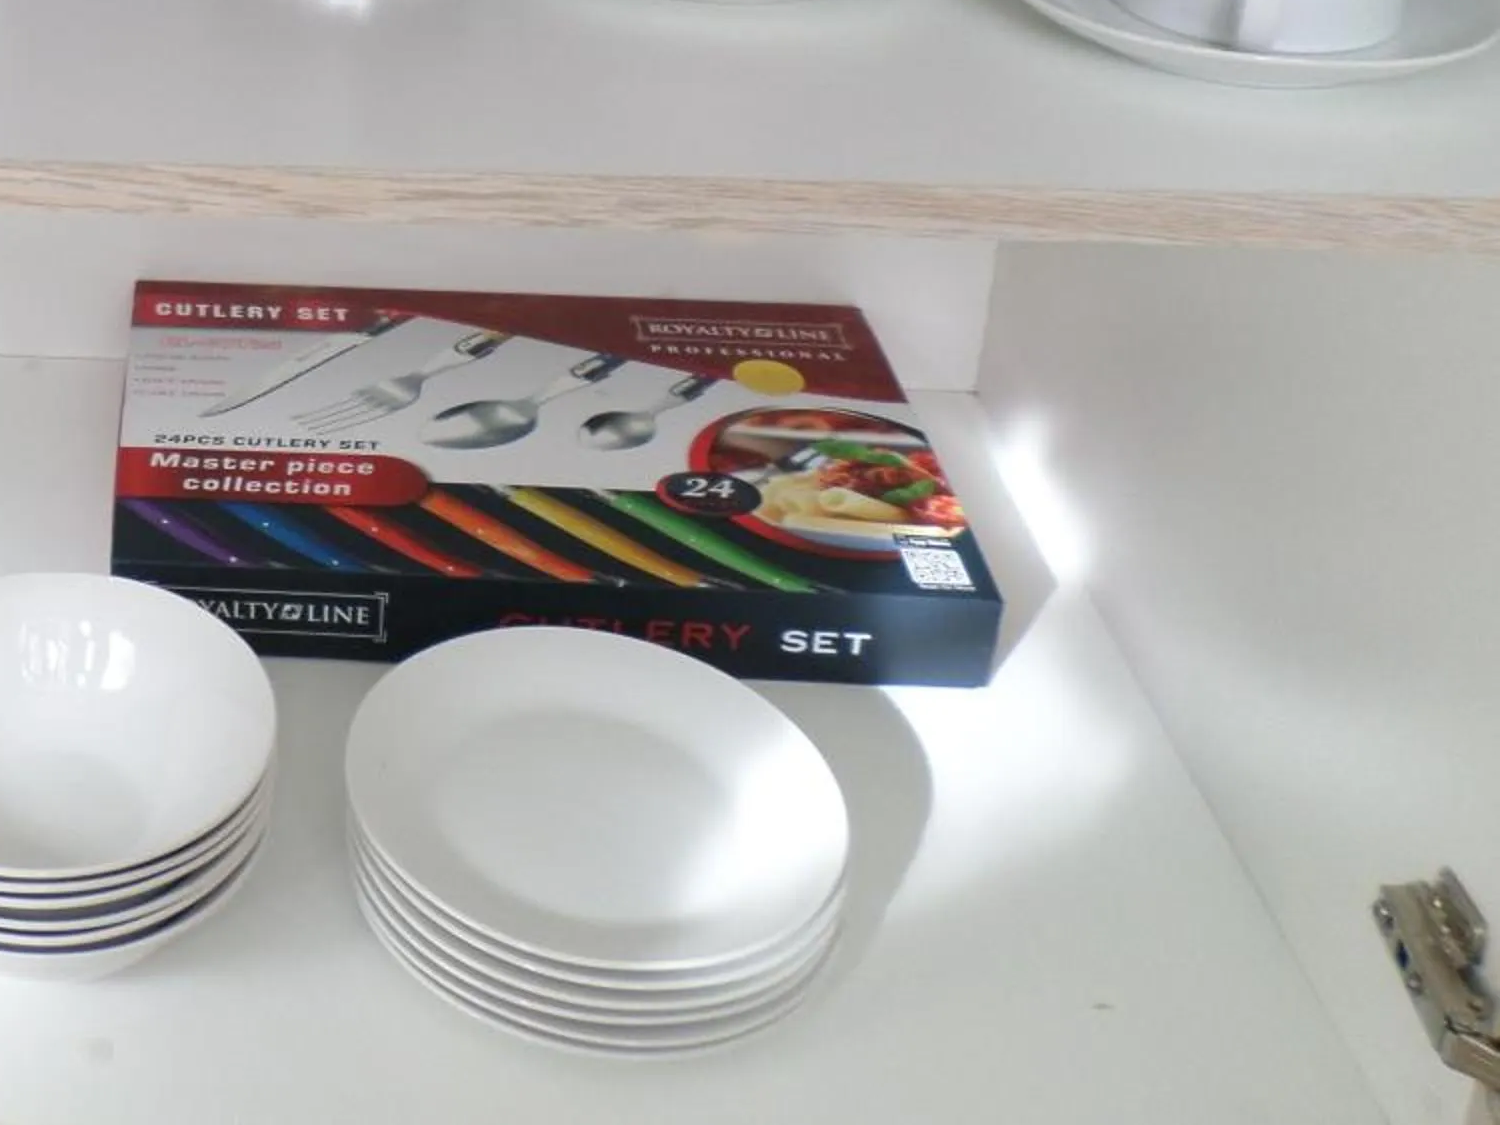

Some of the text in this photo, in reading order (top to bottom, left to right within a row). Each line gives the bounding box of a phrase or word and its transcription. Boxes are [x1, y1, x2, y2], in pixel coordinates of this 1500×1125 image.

[155, 302, 349, 321] CUTLERY SET
[648, 324, 830, 340] ROYALTY LINE
[154, 434, 380, 450] 24PCS CUTLERY SET
[150, 452, 375, 475] Master piece
[182, 476, 352, 496] collection
[680, 478, 736, 498] 24
[195, 599, 370, 625] YALTY LINE
[780, 629, 873, 656] SET
